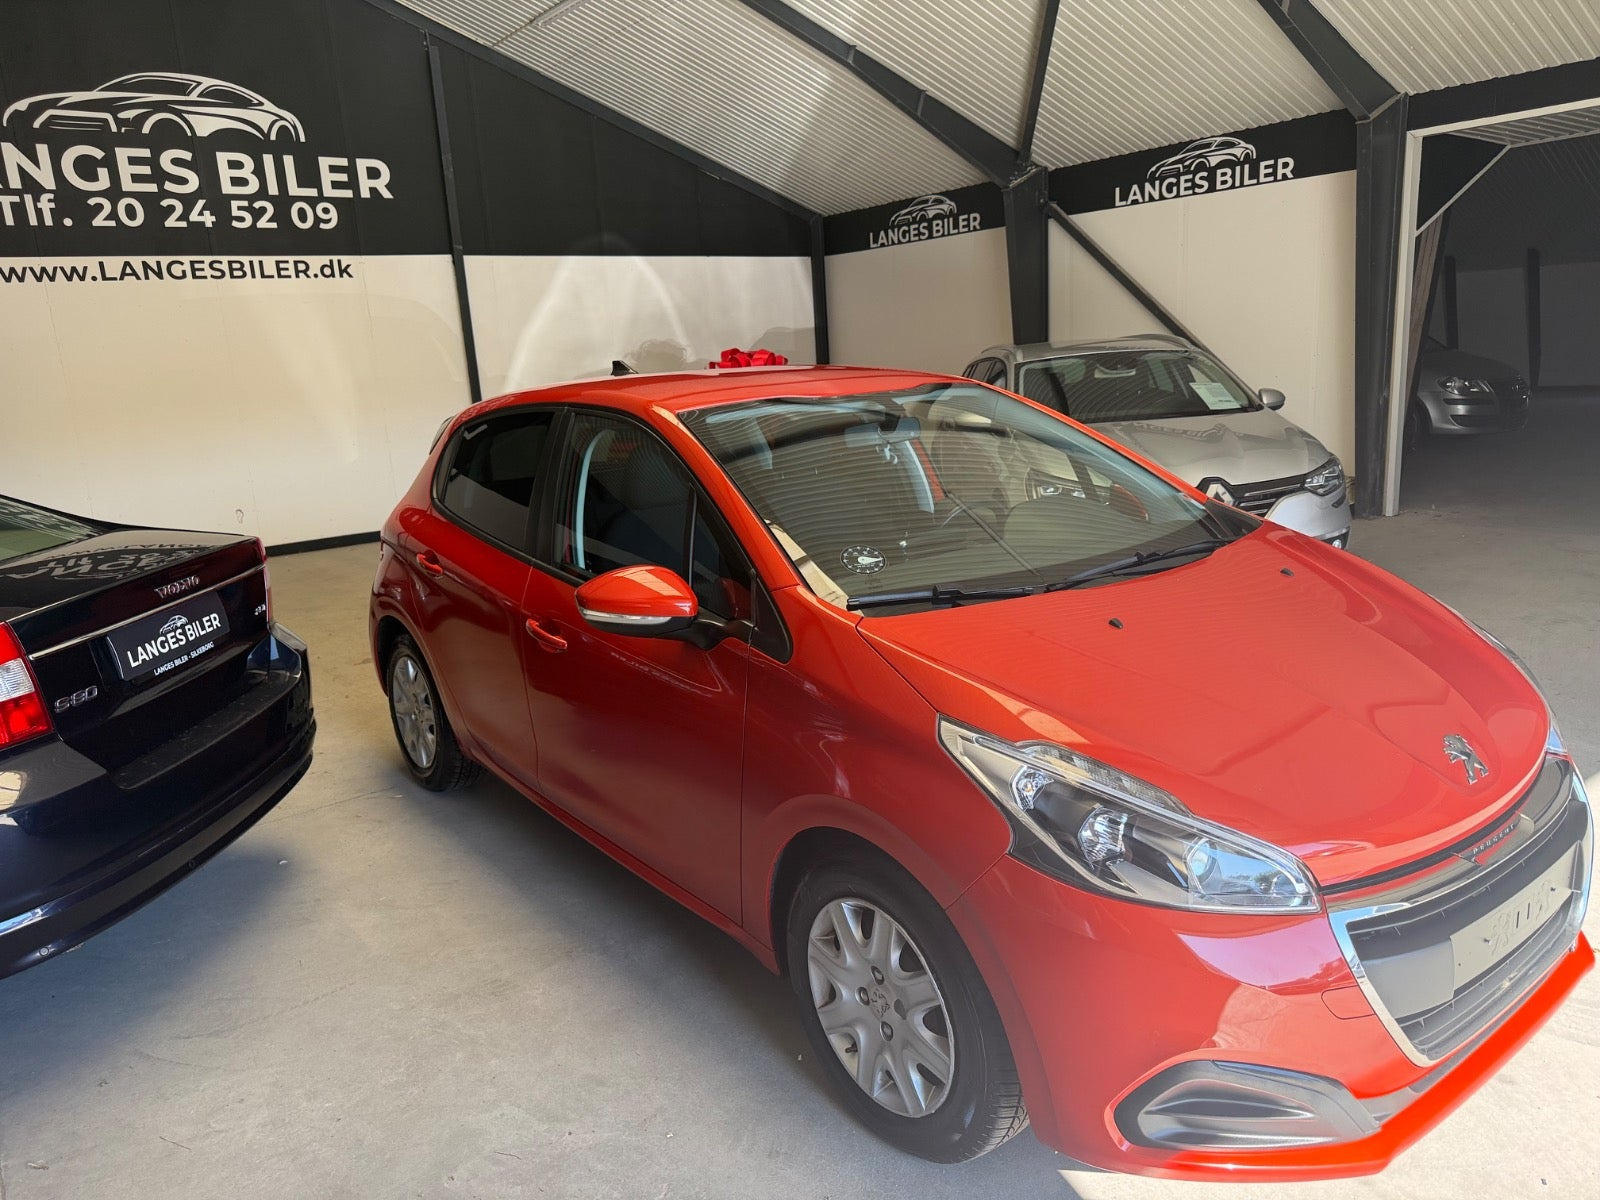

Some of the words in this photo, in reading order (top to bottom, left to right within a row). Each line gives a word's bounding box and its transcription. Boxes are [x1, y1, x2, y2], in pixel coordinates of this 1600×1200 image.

[0, 142, 200, 194] NGES
[216, 151, 394, 199] BILER
[1115, 171, 1209, 207] LANGES
[1215, 157, 1295, 190] BILER
[0, 193, 73, 227] Tlf.
[87, 197, 145, 227] 20
[160, 198, 216, 228] 24
[231, 200, 278, 229] 52
[290, 201, 338, 230] 09
[869, 222, 929, 248] LANGES
[932, 212, 981, 237] BILER
[0, 259, 354, 283] www.LANGESBILER.dk
[154, 575, 200, 598] VOLVO
[127, 629, 187, 668] LANGES
[185, 613, 221, 641] BILER
[153, 661, 175, 676] LANGES
[173, 655, 189, 667] BILER
